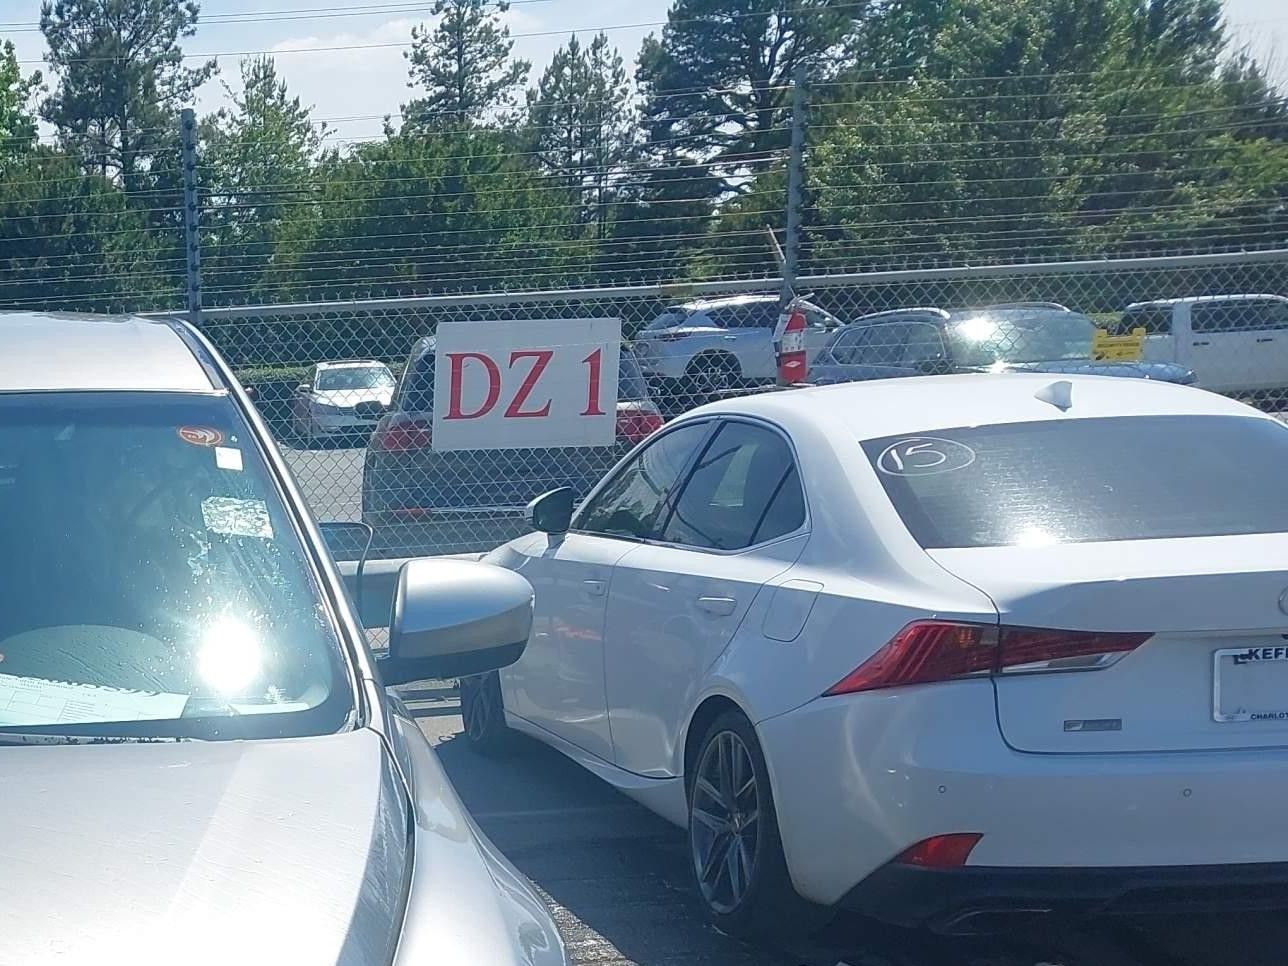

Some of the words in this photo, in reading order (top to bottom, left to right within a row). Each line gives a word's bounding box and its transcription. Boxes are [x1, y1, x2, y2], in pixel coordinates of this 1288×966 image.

[443, 350, 554, 420] DZ
[579, 347, 607, 417] 1
[890, 443, 946, 471] 15
